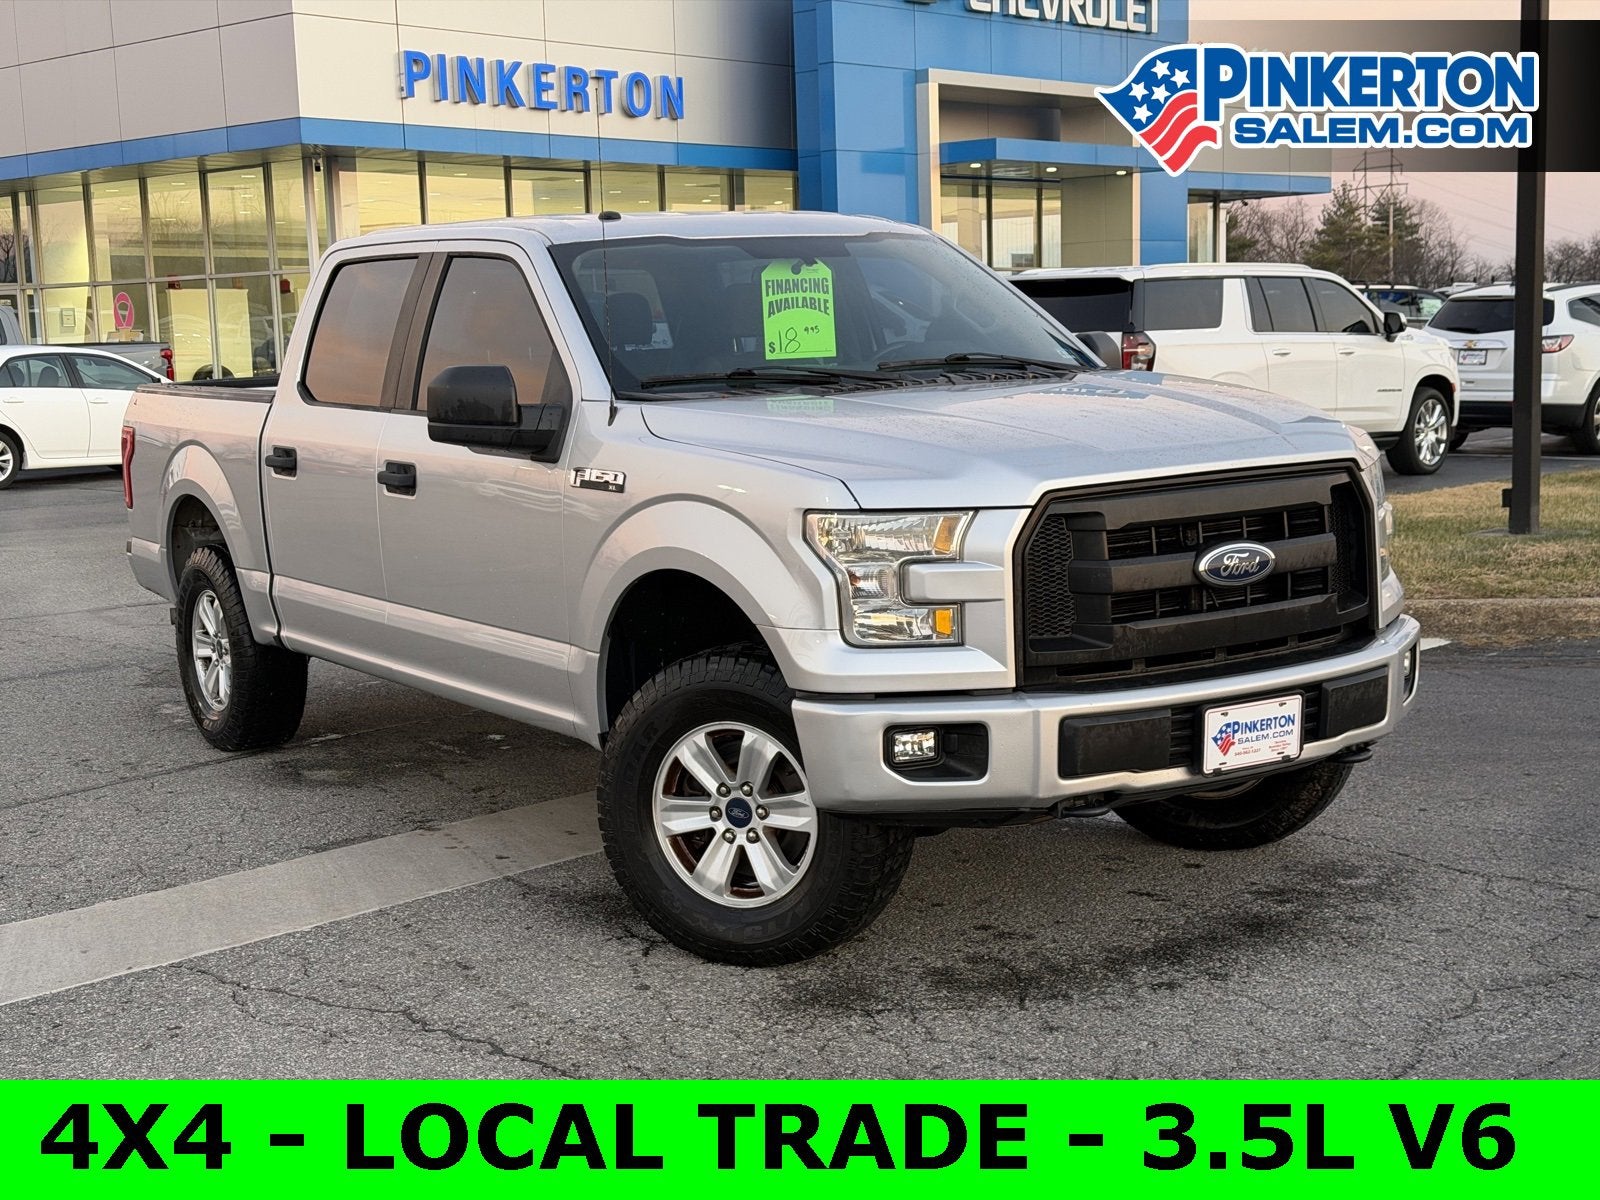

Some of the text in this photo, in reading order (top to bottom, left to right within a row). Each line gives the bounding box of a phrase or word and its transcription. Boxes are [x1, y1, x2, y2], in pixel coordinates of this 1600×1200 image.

[970, 0, 1158, 33] VROLET
[400, 50, 684, 119] PINKERTON
[765, 277, 829, 297] FINANCING
[768, 297, 830, 318] AVAILABLE
[1220, 552, 1260, 577] Ford
[1232, 714, 1296, 740] PINKERTON
[1237, 729, 1294, 745] SALEM.COM
